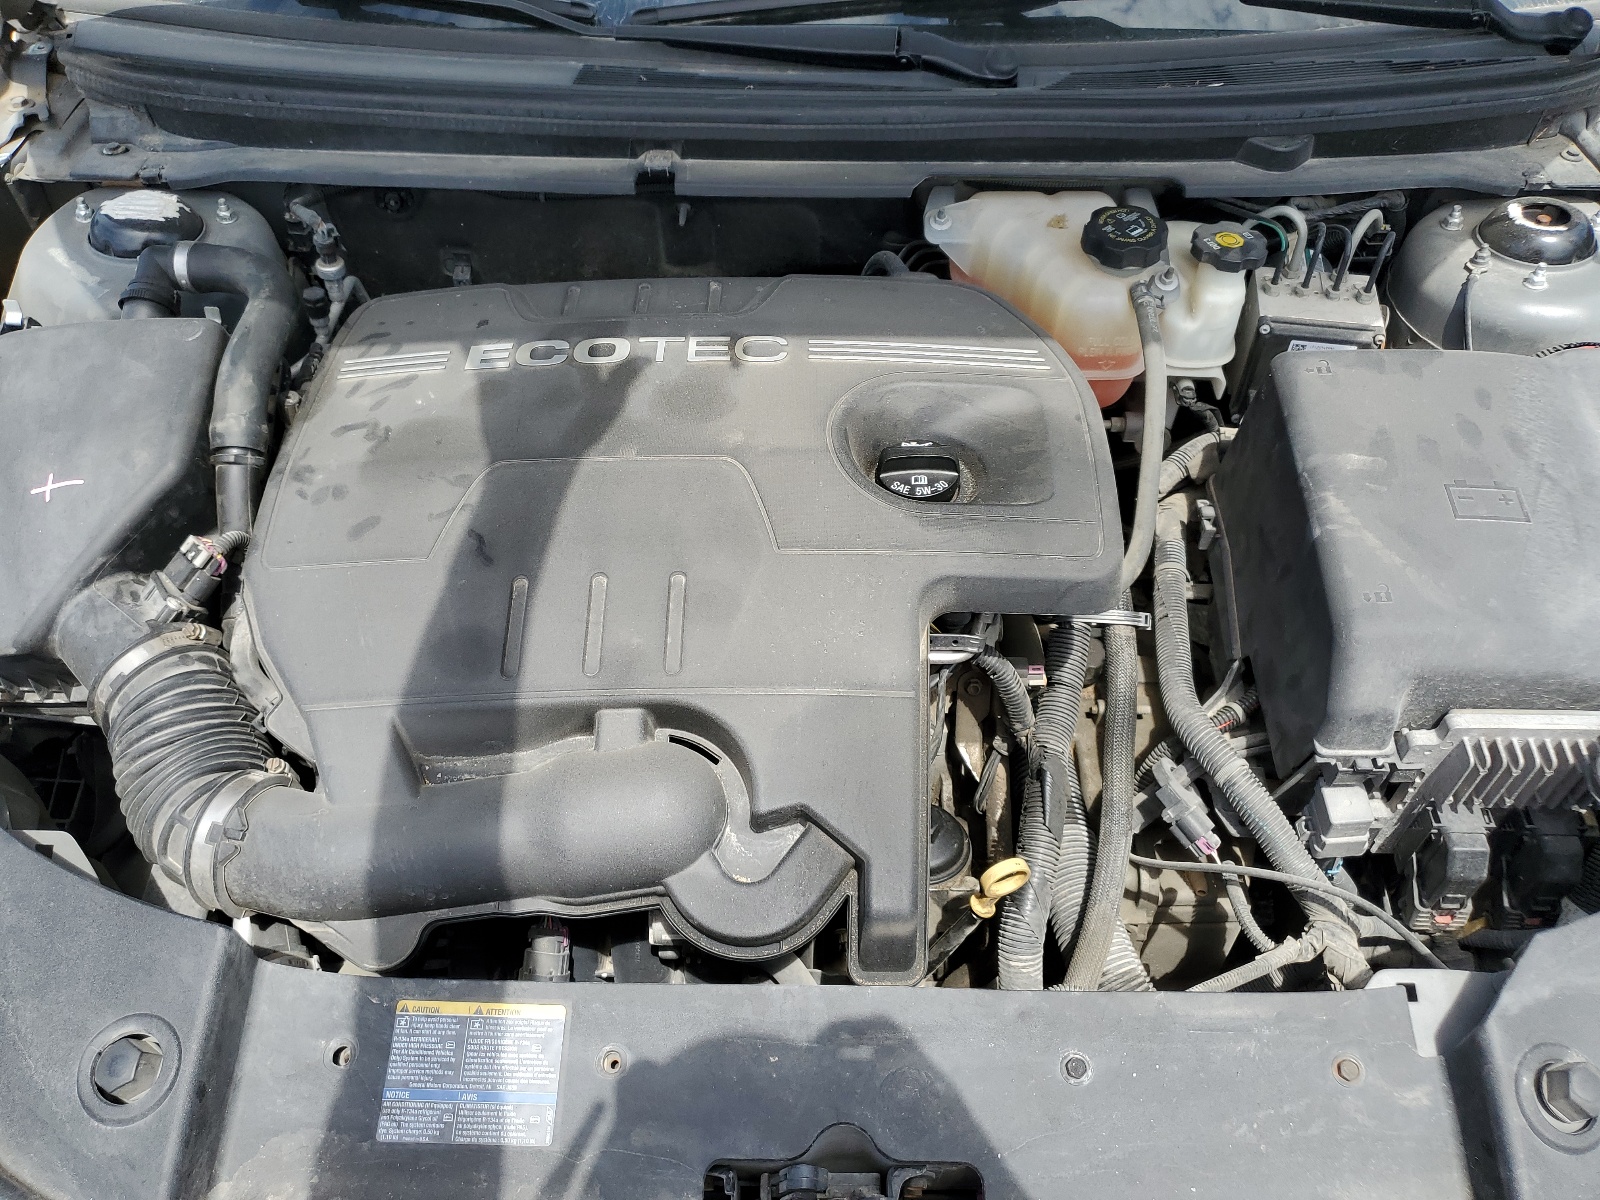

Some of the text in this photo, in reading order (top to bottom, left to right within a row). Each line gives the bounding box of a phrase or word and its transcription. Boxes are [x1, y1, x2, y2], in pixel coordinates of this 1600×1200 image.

[464, 336, 788, 370] ECOTEC
[890, 480, 948, 496] SAE 5W-30
[386, 1090, 410, 1098] NOTICE
